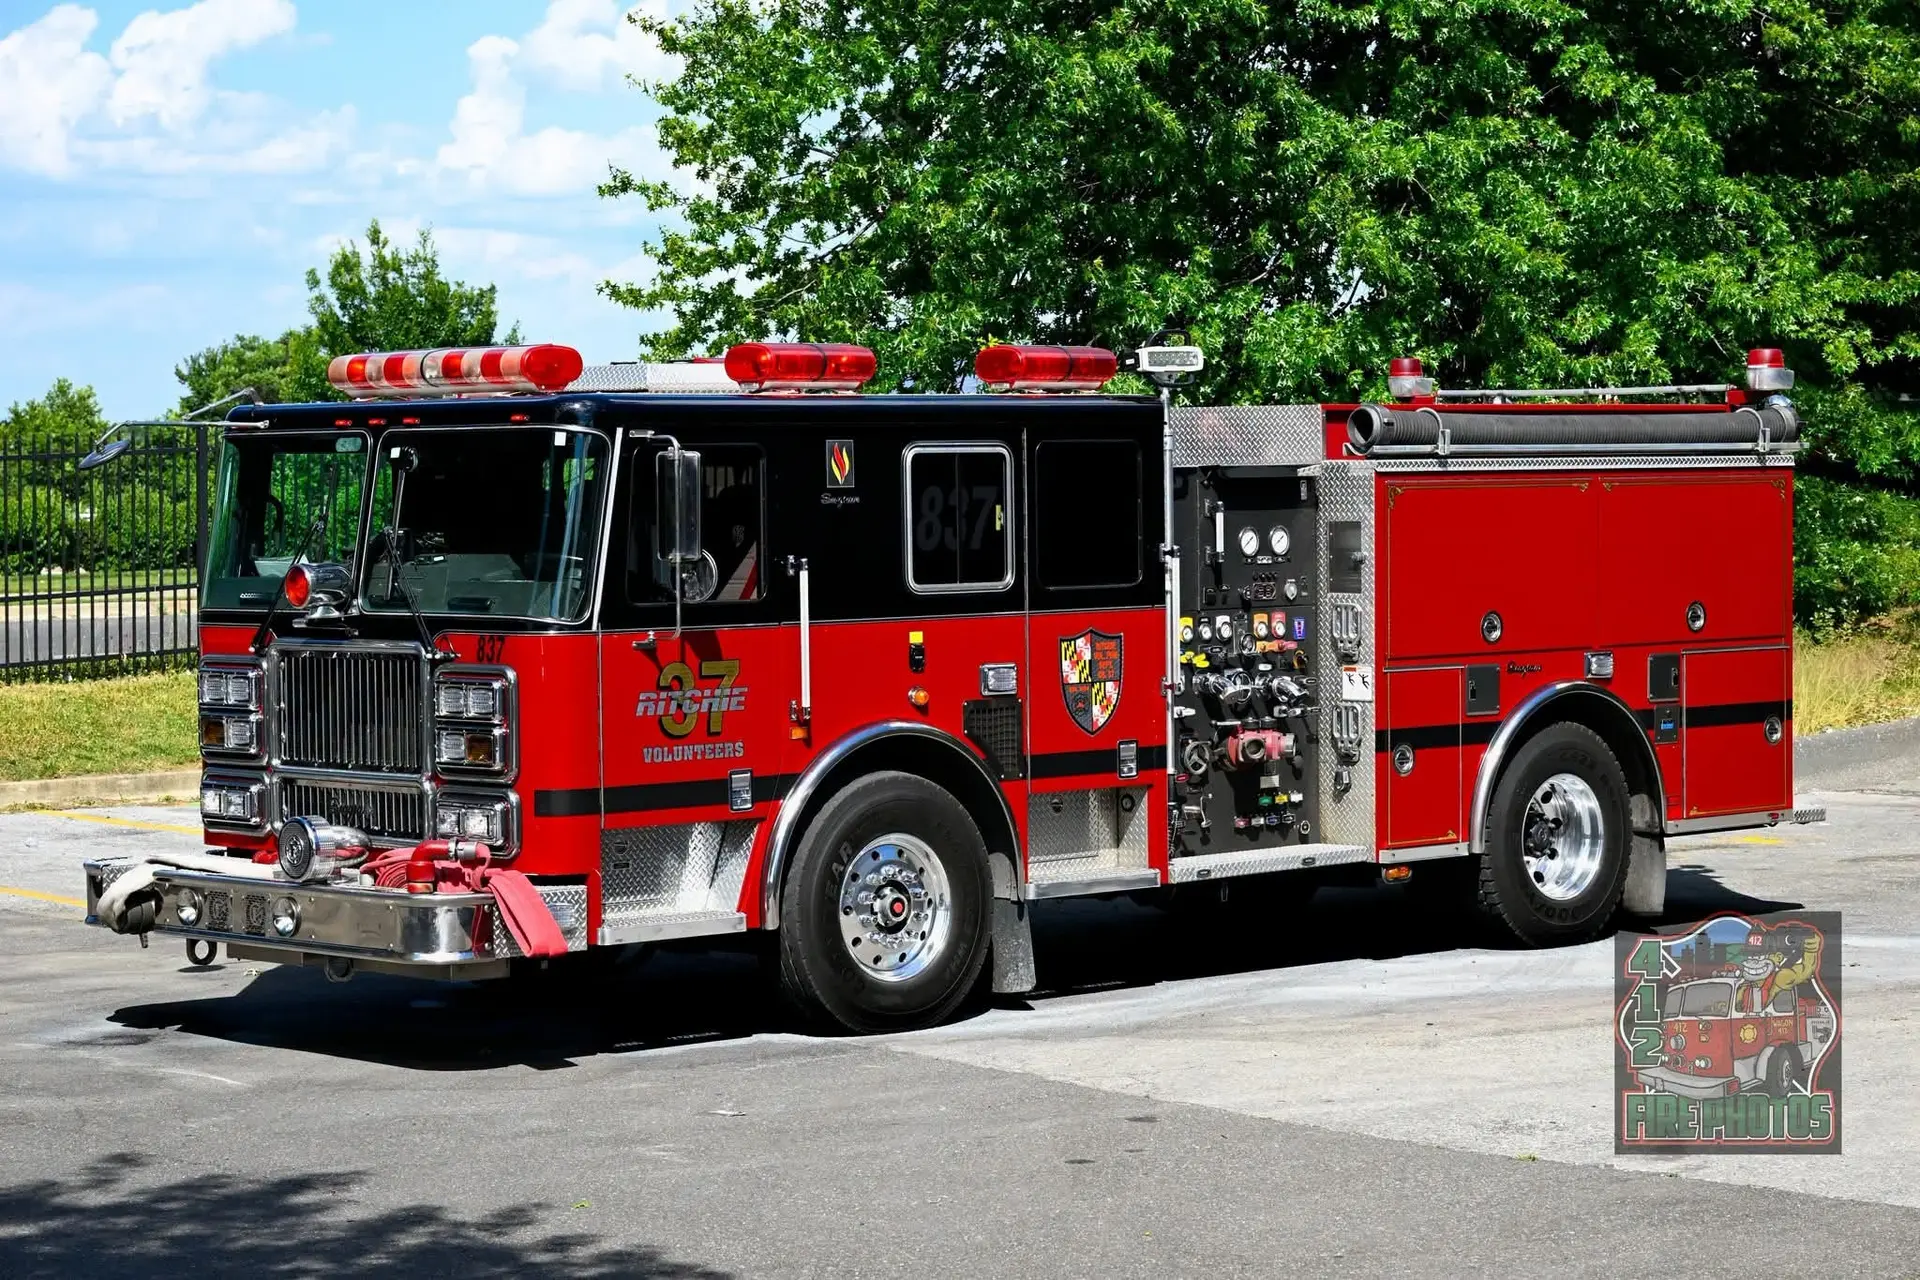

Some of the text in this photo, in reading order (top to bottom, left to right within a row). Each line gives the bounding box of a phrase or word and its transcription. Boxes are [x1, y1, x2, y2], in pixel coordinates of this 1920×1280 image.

[916, 485, 999, 551] 837
[476, 634, 506, 664] 837
[636, 687, 748, 716] RITCHIE
[658, 660, 740, 738] 37
[643, 742, 745, 763] VOLUNTEERS
